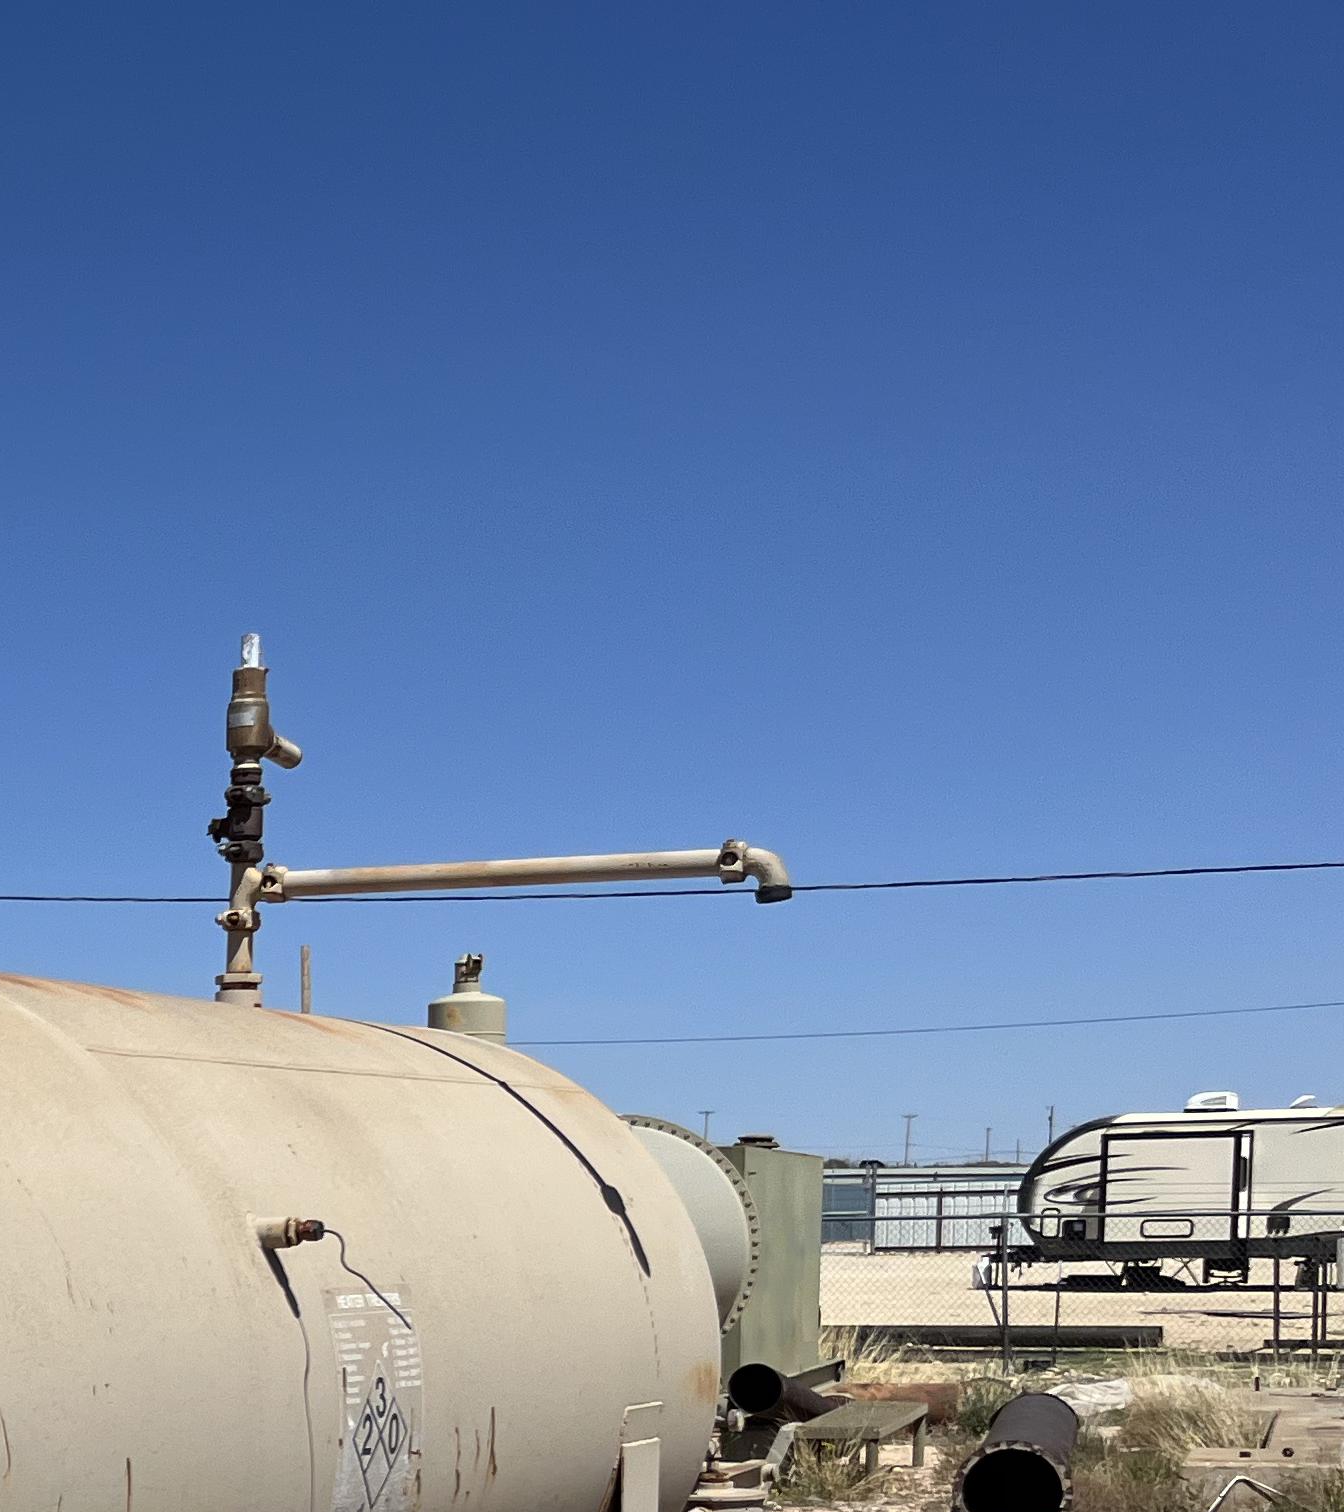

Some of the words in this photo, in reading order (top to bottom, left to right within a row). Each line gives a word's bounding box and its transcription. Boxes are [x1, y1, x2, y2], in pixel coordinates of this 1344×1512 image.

[375, 1377, 387, 1418] 3
[361, 1414, 373, 1456] 2
[388, 1413, 400, 1454] 0
